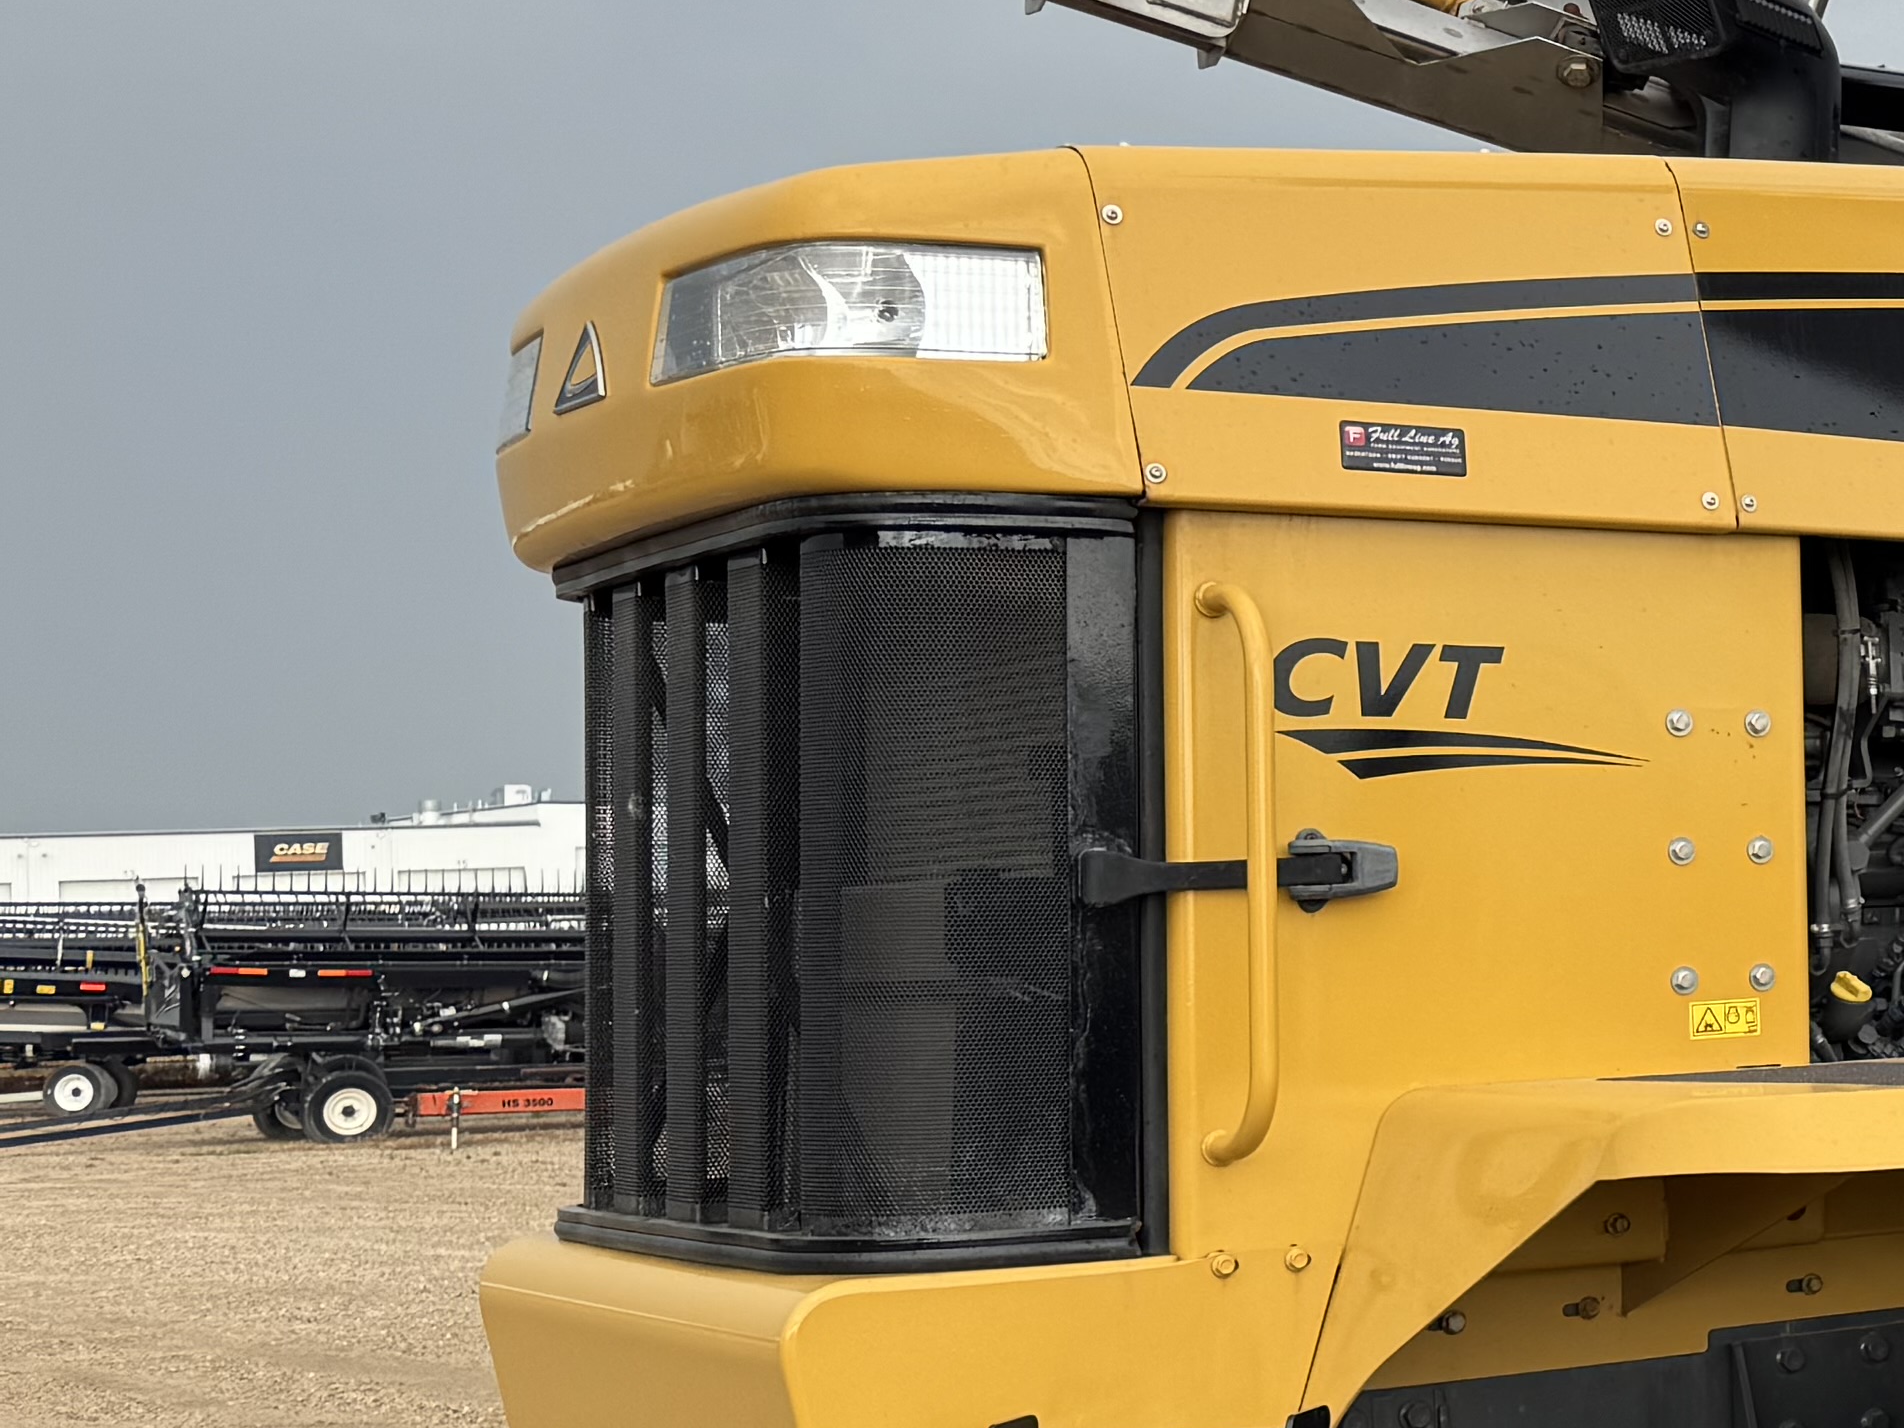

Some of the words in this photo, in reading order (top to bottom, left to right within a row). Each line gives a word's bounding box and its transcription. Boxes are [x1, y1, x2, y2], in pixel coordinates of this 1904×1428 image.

[1368, 426, 1400, 442] Full
[1401, 429, 1435, 443] Line
[1437, 432, 1459, 448] Ag
[1273, 637, 1505, 720] CVT
[273, 842, 329, 856] CASE
